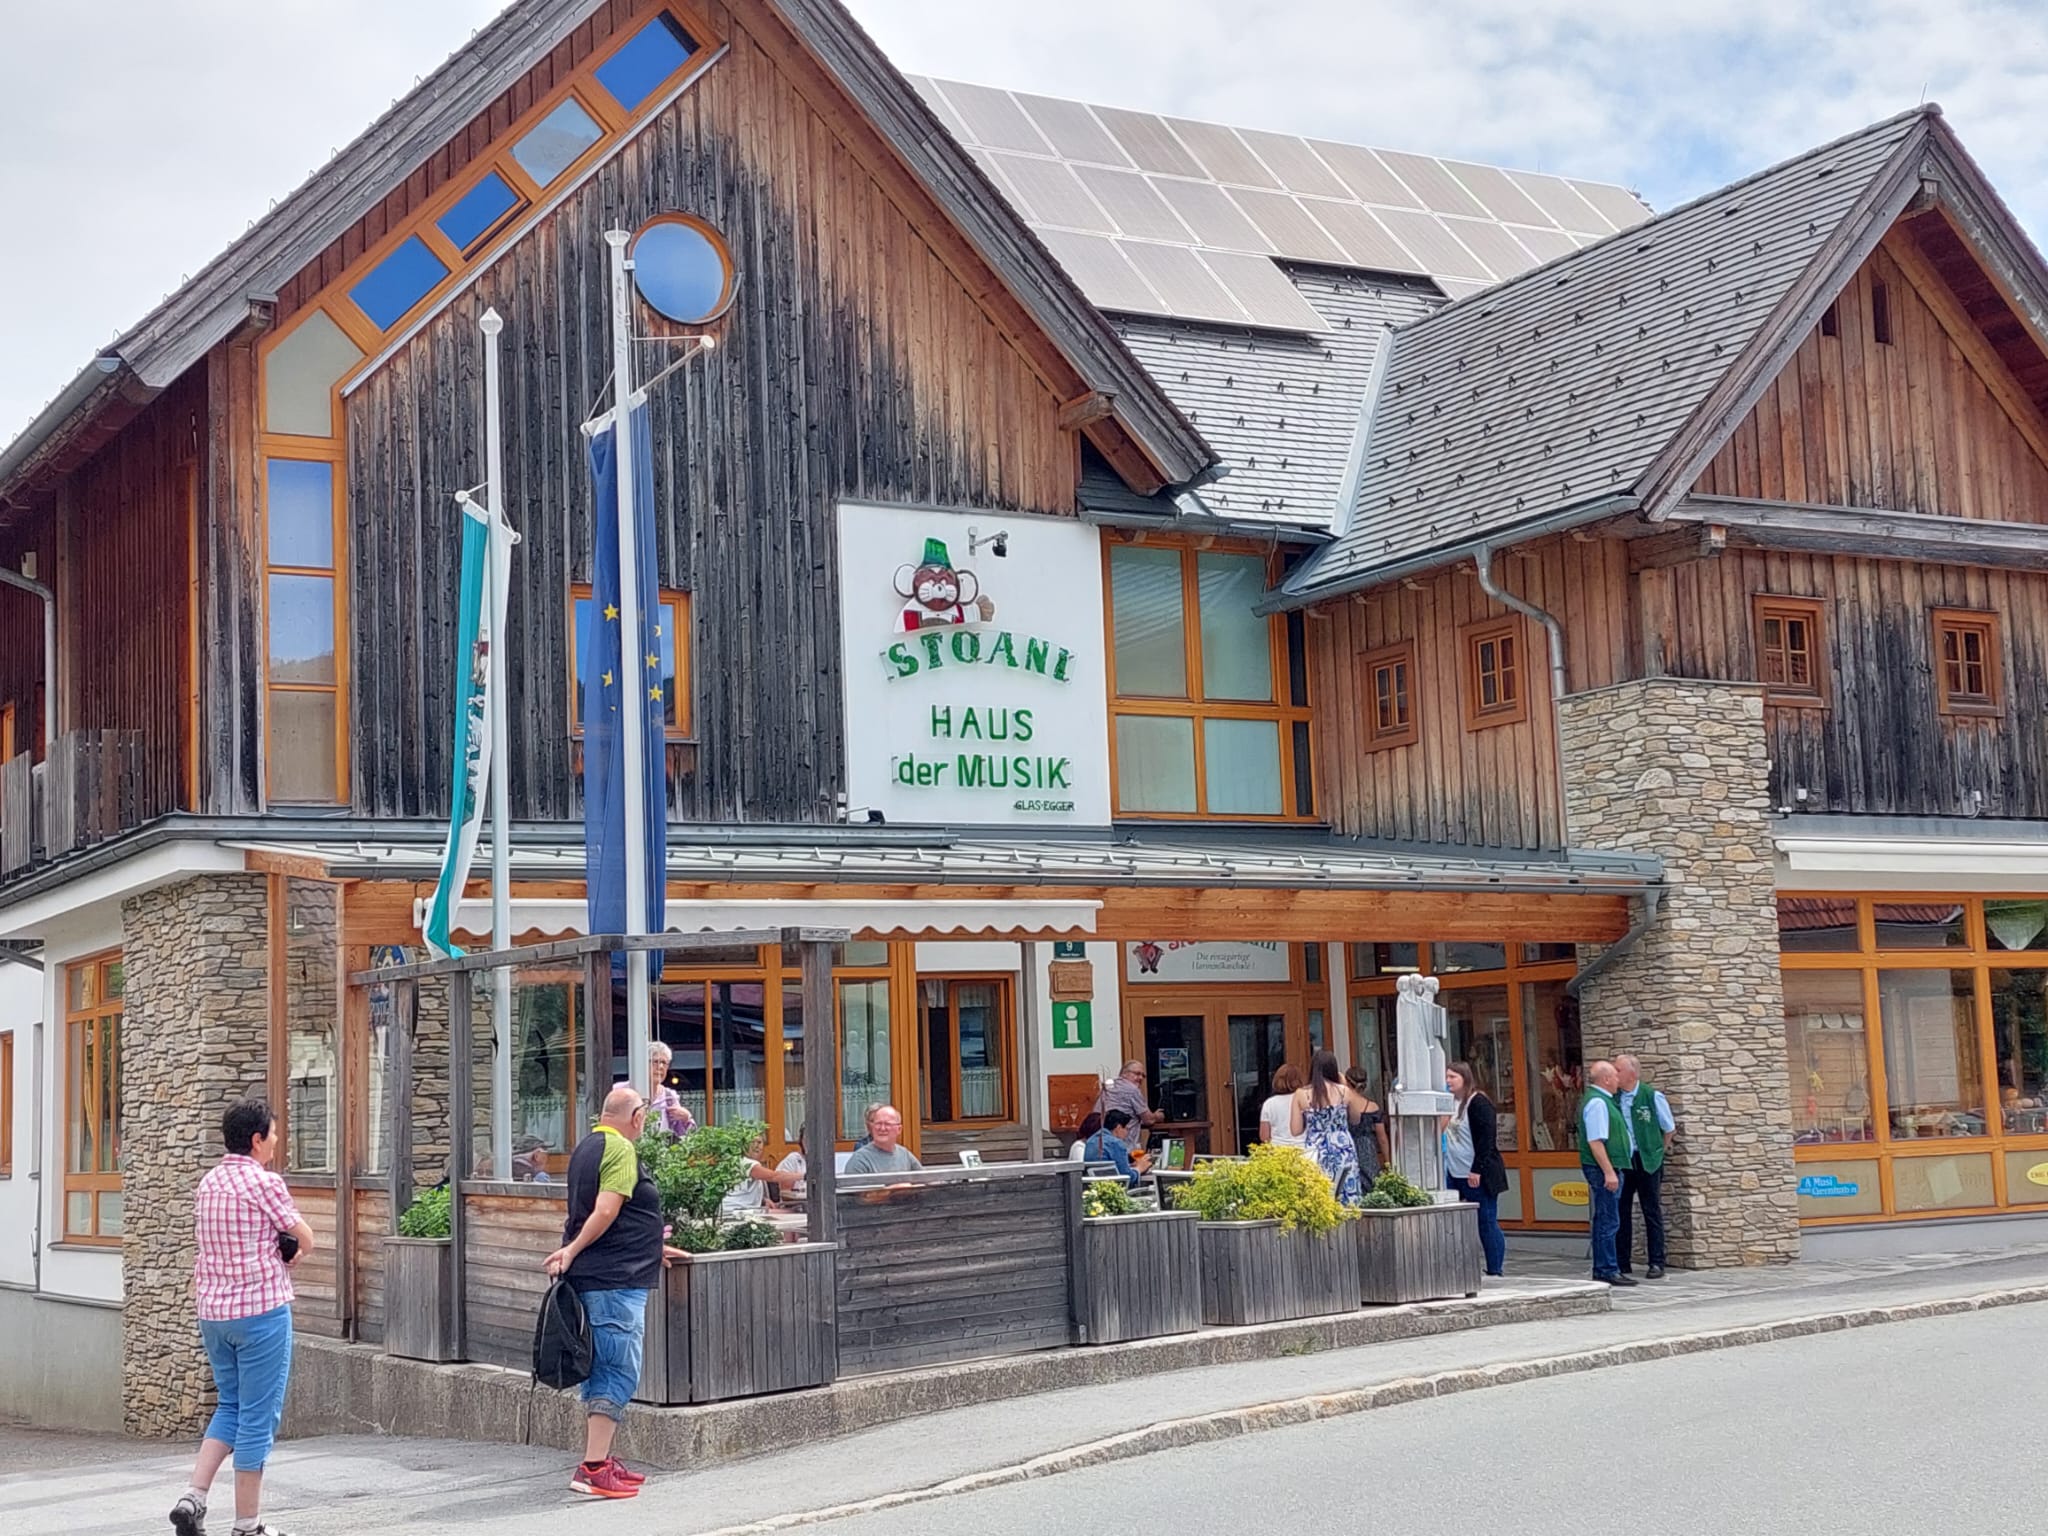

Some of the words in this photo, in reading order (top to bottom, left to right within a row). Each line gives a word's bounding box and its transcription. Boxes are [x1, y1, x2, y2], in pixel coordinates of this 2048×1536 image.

[888, 631, 1070, 681] STOANI
[931, 705, 1033, 741] HAUS
[899, 753, 949, 785] der
[957, 754, 1068, 788] MUSIK
